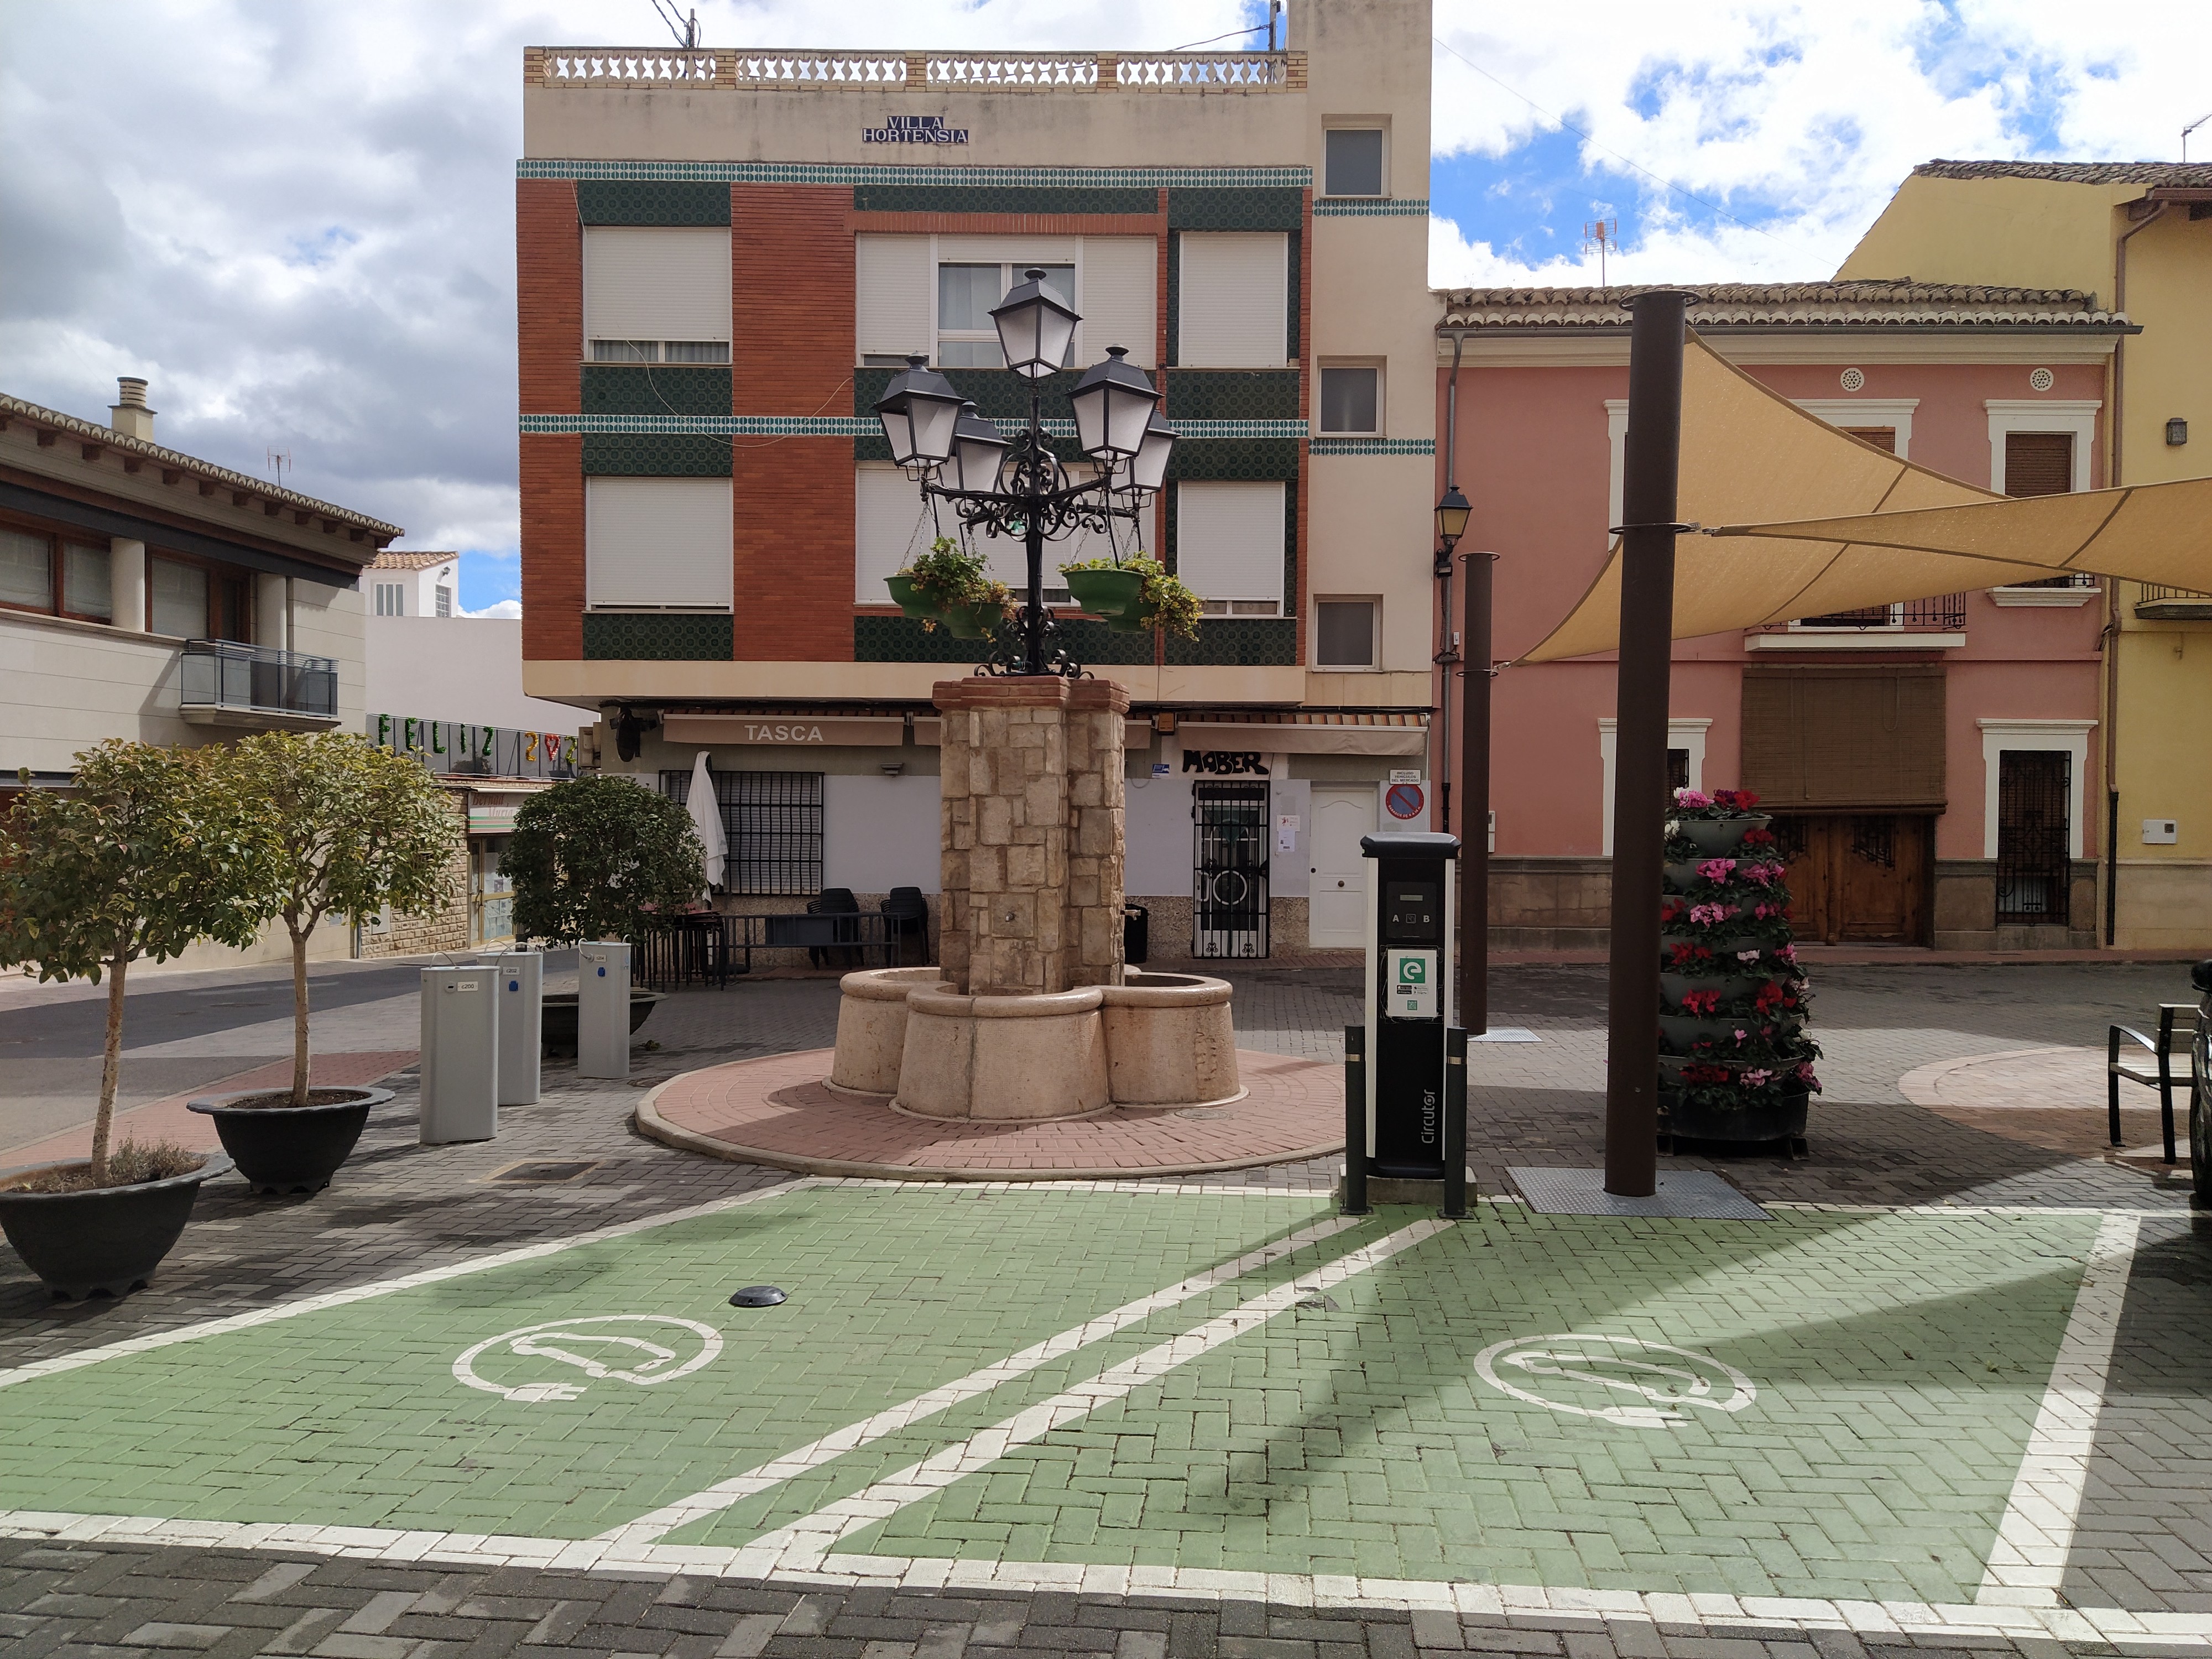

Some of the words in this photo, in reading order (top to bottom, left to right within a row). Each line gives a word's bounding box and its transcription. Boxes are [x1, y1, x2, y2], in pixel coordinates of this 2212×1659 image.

[888, 669, 943, 682] VILLA
[863, 682, 968, 695] HORTENSIA
[378, 713, 494, 756] FELIZ
[744, 725, 823, 742] TASCA
[1392, 914, 1400, 922] A
[1423, 915, 1430, 923] B
[1421, 1089, 1435, 1144] Circutor
